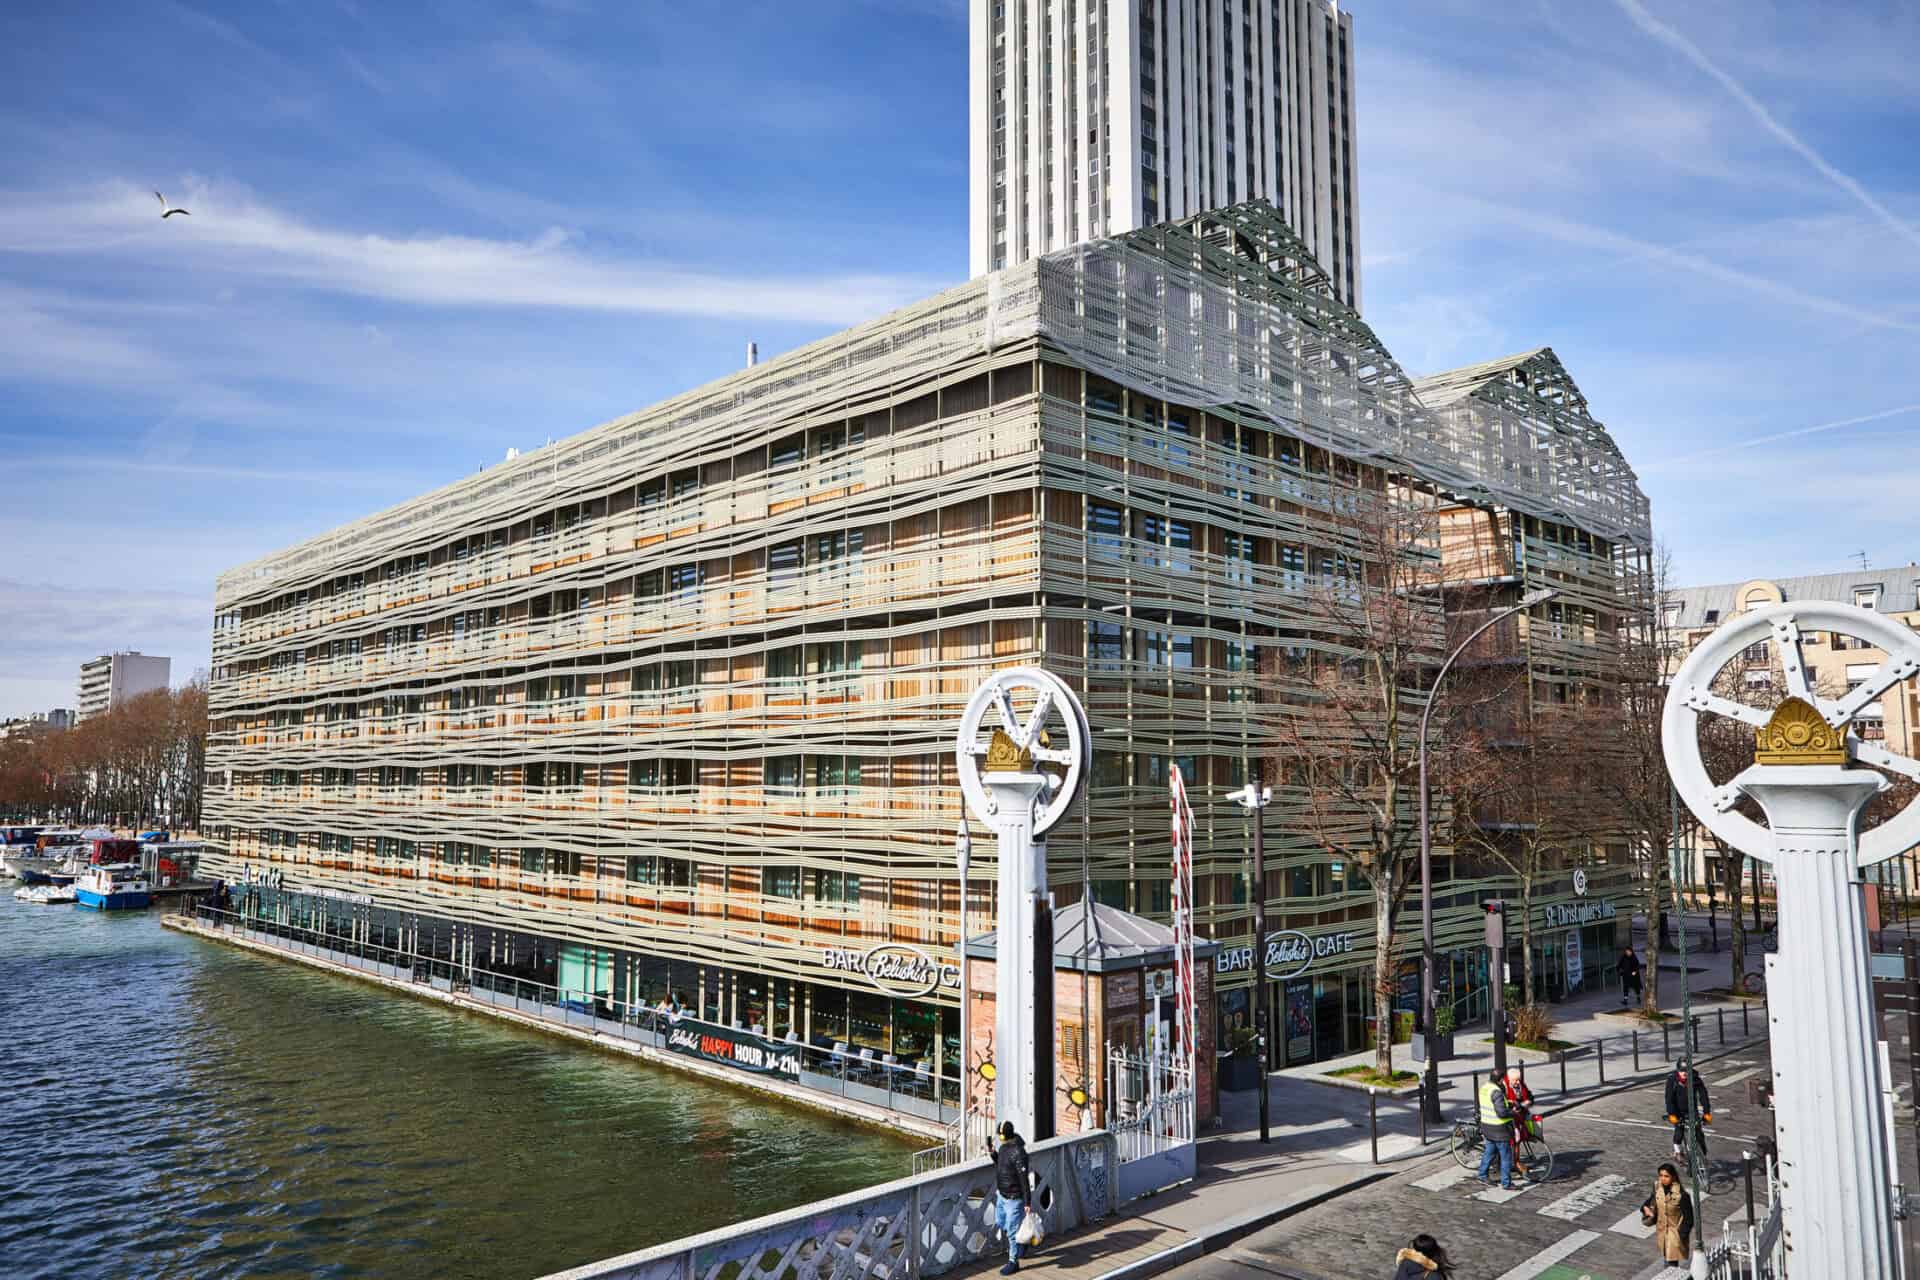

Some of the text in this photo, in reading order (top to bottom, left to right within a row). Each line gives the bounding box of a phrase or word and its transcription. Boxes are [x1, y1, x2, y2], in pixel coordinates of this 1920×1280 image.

[823, 948, 864, 973] BAR
[873, 953, 928, 984] Belushi's
[1217, 933, 1353, 972] BAR Belushi's CAFE
[700, 1034, 734, 1059] HAPPY
[734, 1042, 763, 1067] HOUR
